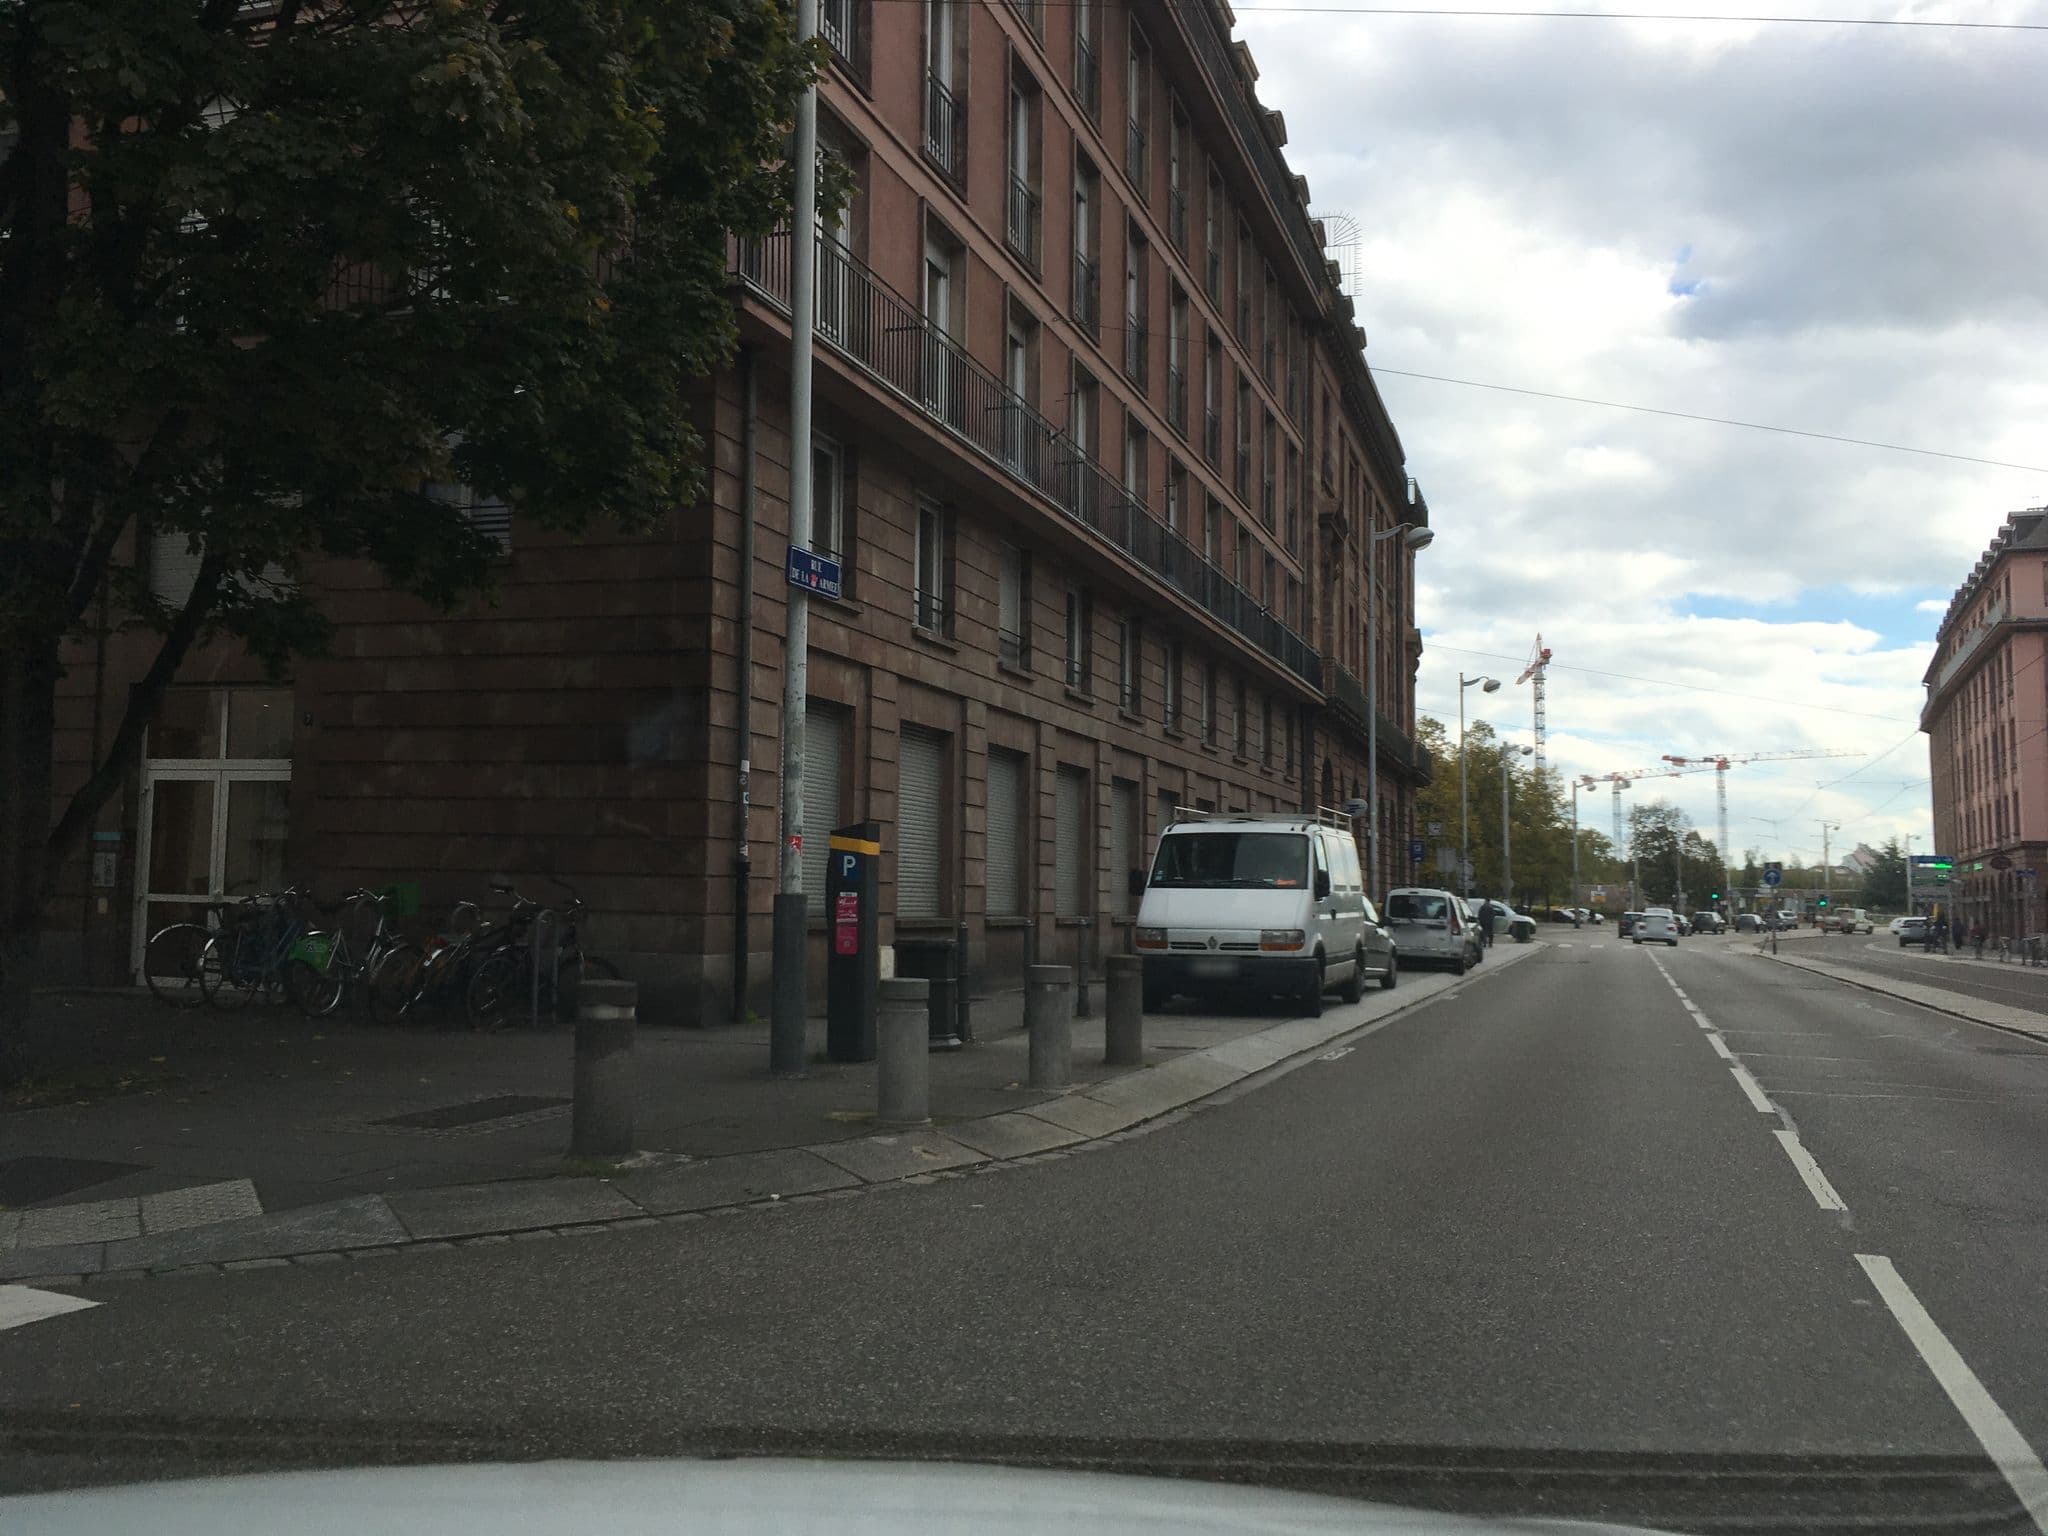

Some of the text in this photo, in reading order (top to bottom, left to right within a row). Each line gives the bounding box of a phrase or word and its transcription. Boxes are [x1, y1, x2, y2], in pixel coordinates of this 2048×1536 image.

[811, 559, 823, 573] RUE
[791, 567, 800, 580] DE
[801, 570, 809, 583] LA
[843, 855, 856, 876] P
